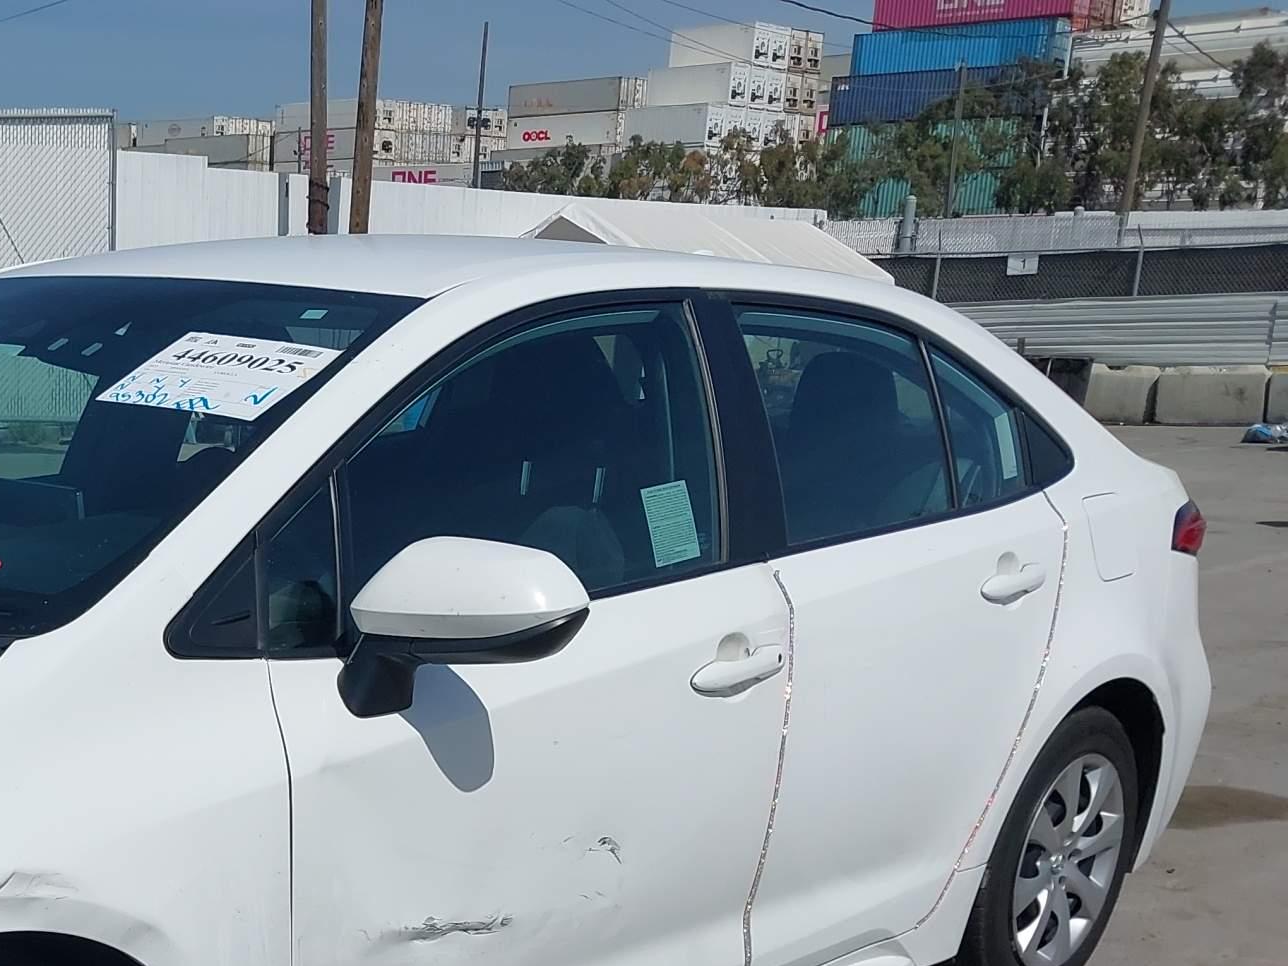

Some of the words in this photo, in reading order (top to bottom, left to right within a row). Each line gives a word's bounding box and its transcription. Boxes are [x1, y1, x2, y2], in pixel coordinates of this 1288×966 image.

[523, 131, 550, 142] OOCL
[392, 170, 437, 184] ONE
[1020, 258, 1026, 269] 1
[172, 348, 305, 374] 44609025
